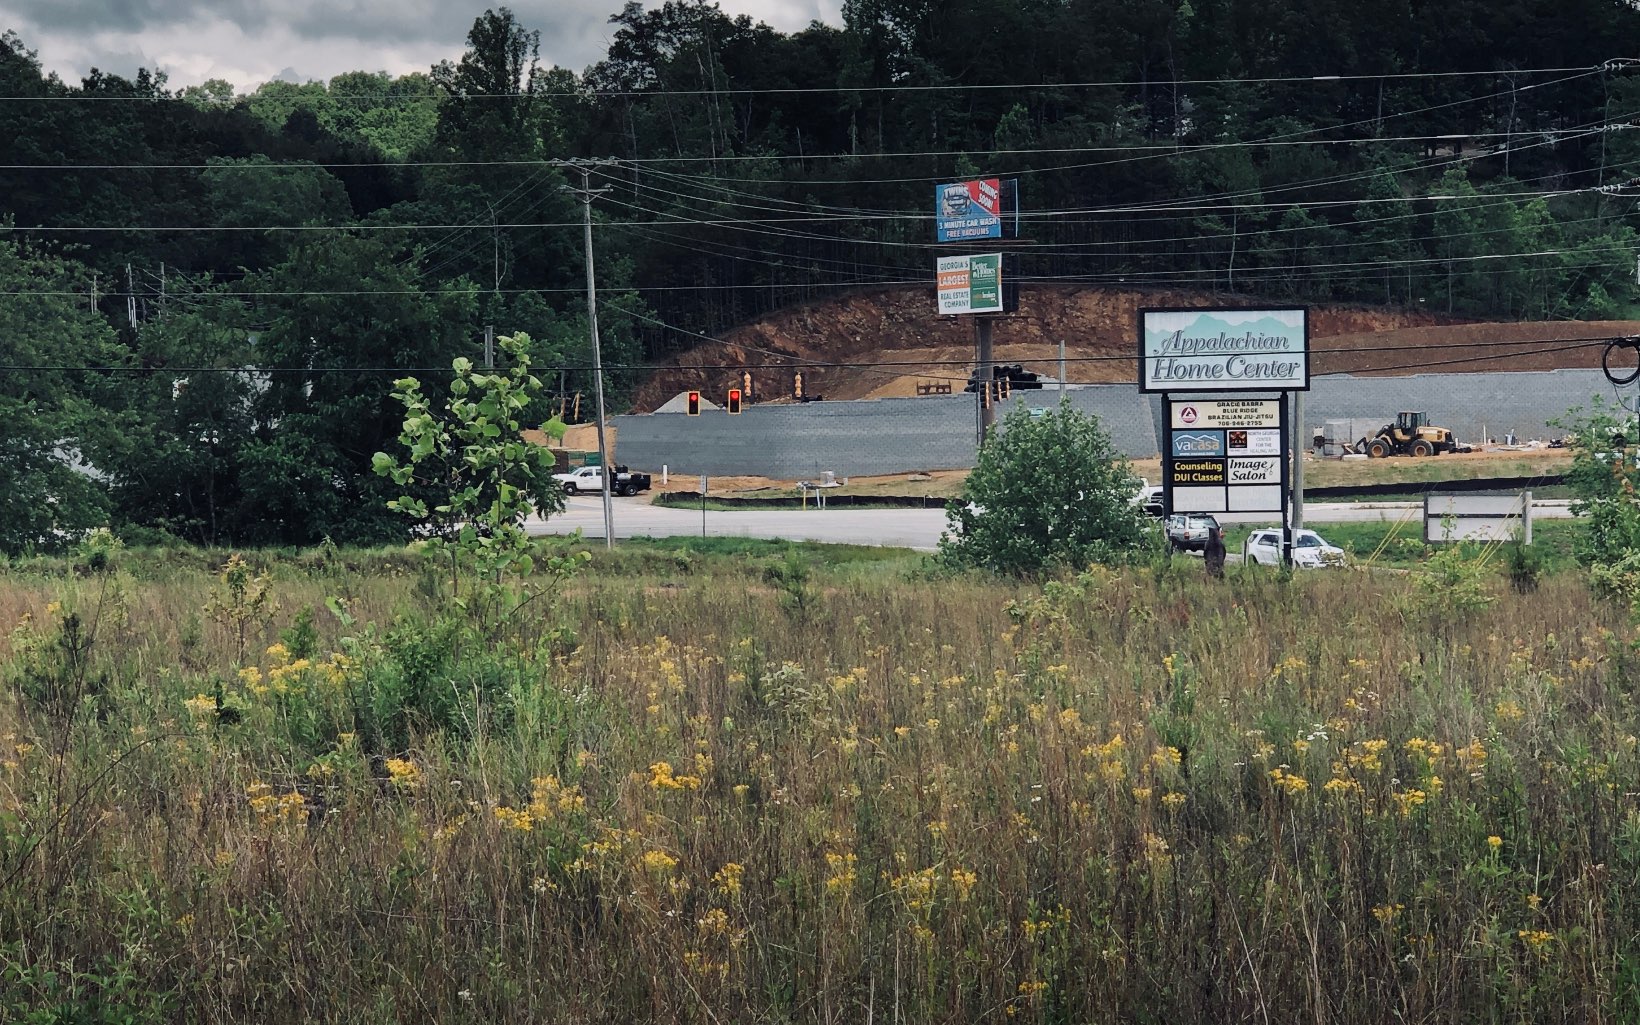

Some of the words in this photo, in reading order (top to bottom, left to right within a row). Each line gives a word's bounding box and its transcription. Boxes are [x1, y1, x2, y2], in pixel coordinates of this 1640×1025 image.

[947, 230, 960, 238] FREE
[962, 228, 989, 237] VACUUMS
[939, 274, 969, 286] LARGEST
[940, 292, 952, 300] REAL
[944, 300, 969, 308] COMPANY
[1153, 330, 1290, 356] Appalachian
[1151, 358, 1224, 380] Home
[1225, 354, 1301, 379] Center
[1175, 441, 1220, 451] vacasa
[1174, 462, 1223, 472] Counseling
[1229, 459, 1268, 470] Image
[1174, 473, 1190, 481] DUI
[1192, 473, 1223, 481] Classes
[1231, 470, 1267, 481] Salon
